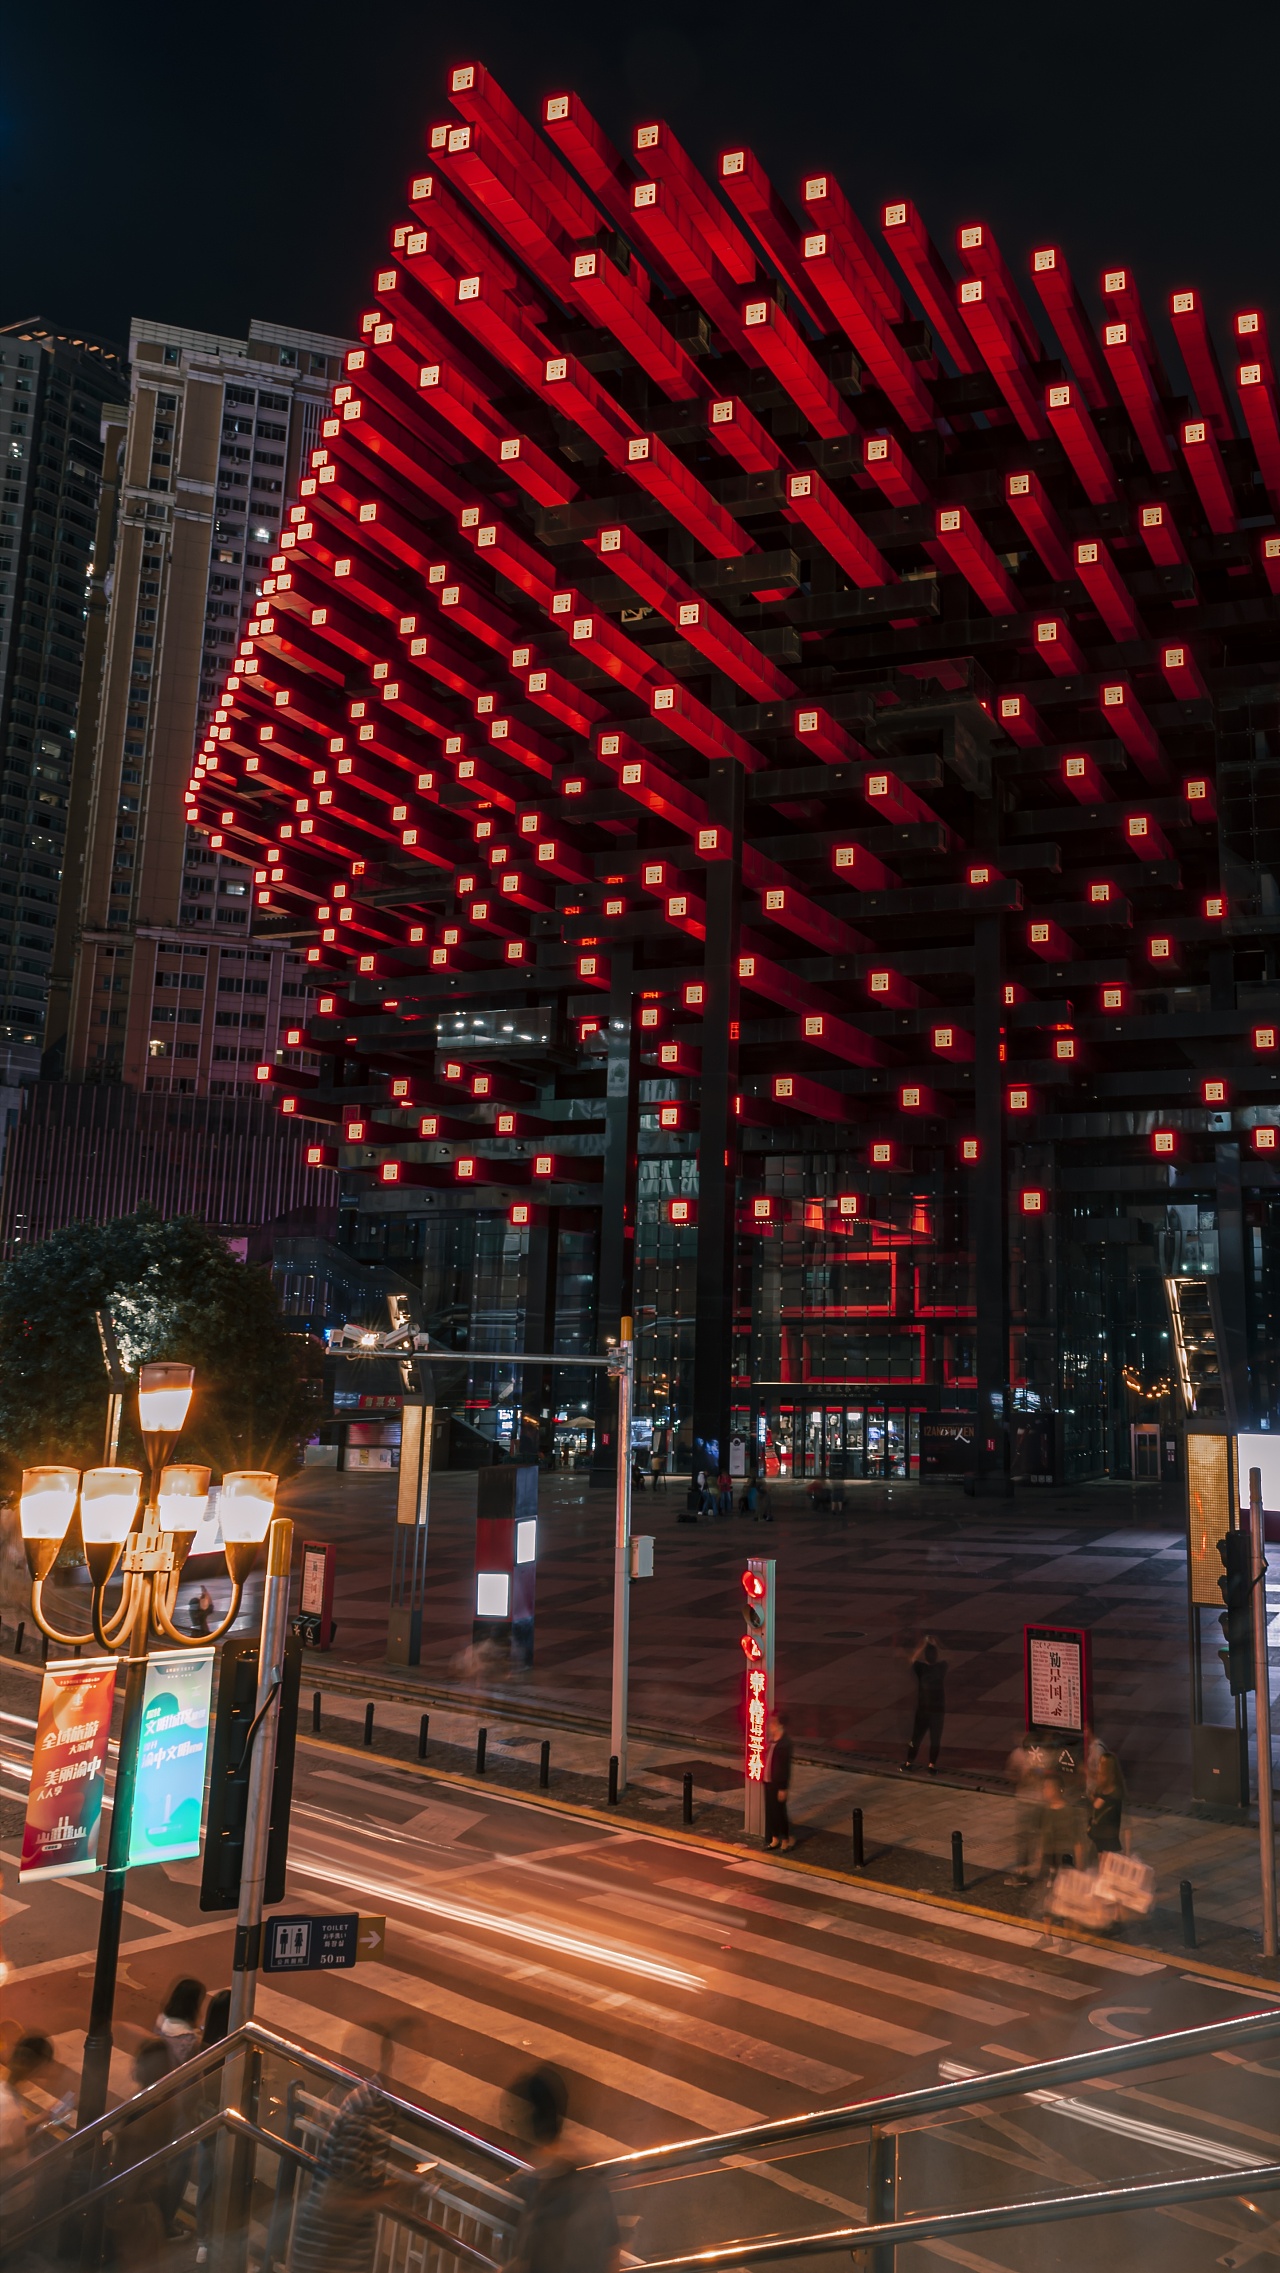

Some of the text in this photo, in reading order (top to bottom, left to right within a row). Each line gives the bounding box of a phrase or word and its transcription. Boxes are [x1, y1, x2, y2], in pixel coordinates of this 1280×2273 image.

[365, 1396, 396, 1408] 售票处
[41, 1720, 100, 1751] 全域旅游
[44, 1755, 102, 1787] 美丽渝中
[36, 1785, 63, 1801] 人人享
[322, 1924, 349, 1932] TOILET
[320, 1954, 346, 1964] 50 m
